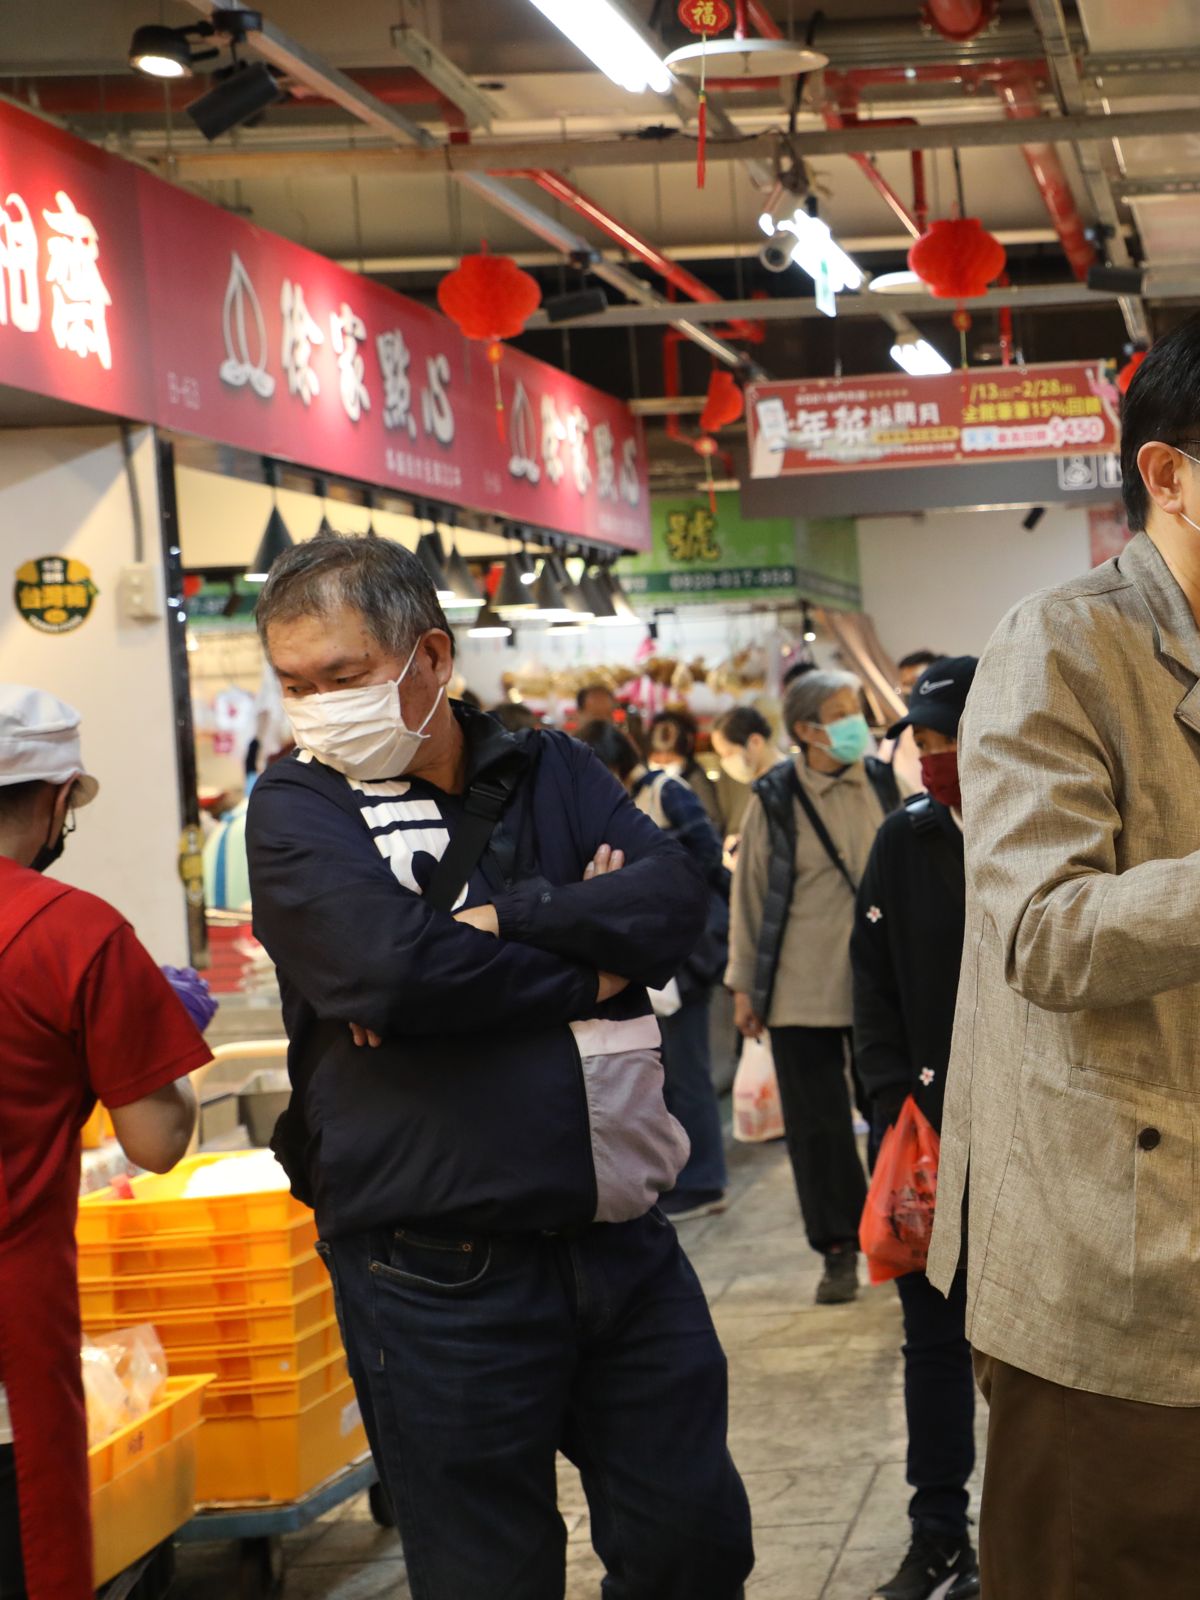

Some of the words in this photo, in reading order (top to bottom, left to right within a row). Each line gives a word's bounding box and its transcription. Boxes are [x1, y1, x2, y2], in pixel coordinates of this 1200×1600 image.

[690, 0, 717, 27] 福
[280, 277, 455, 444] 徐家點心
